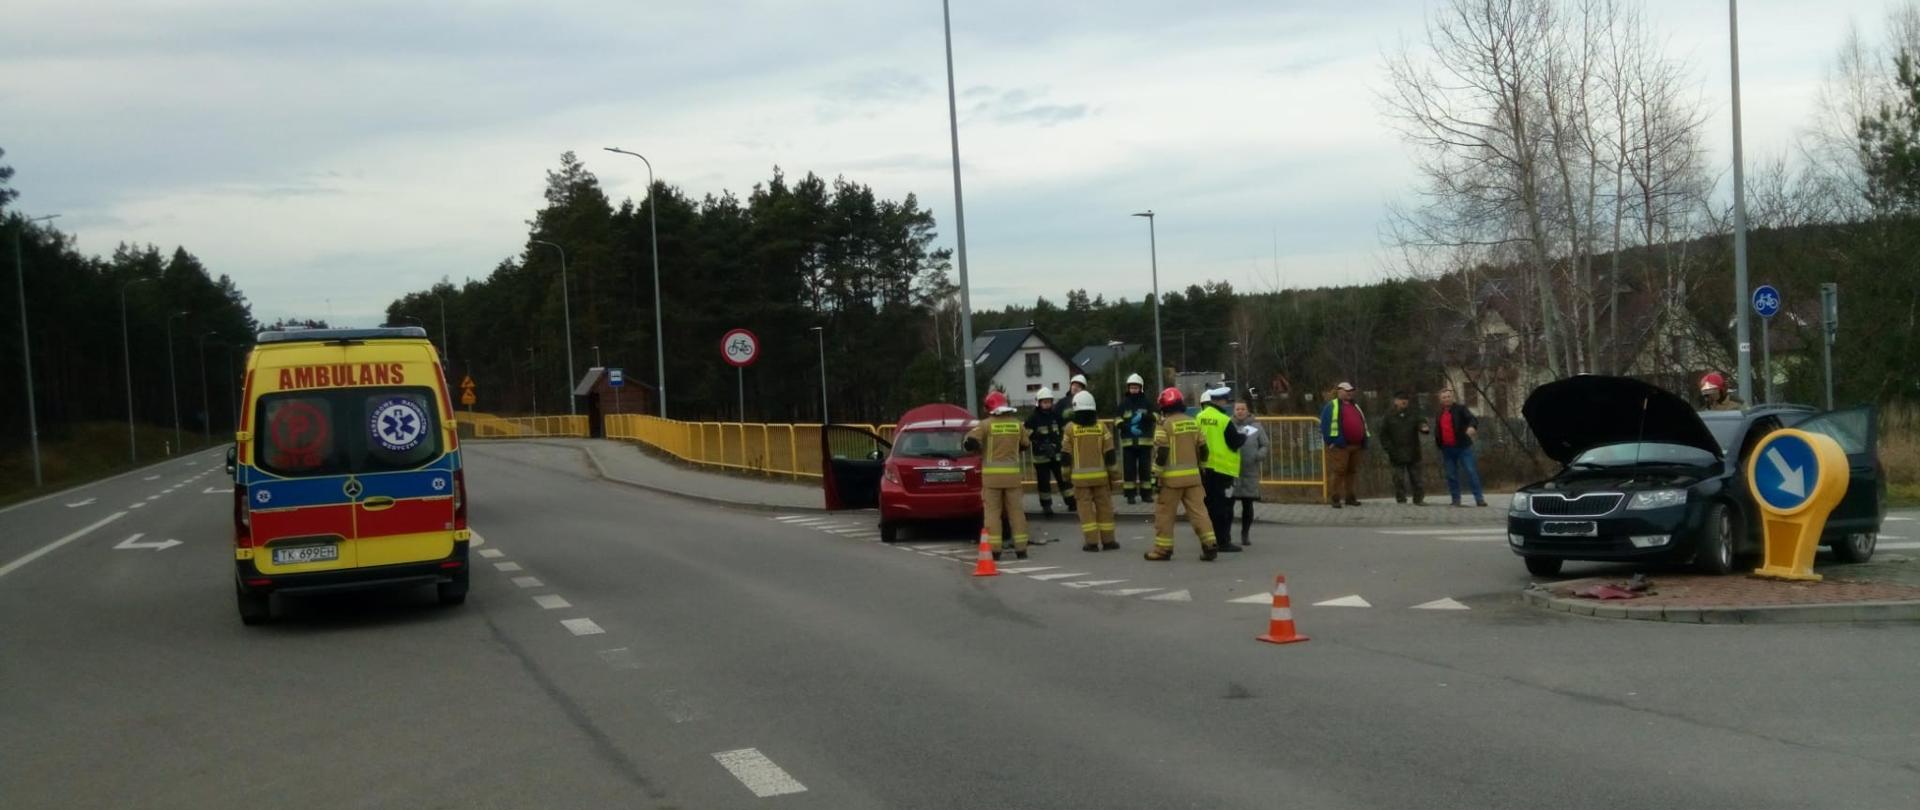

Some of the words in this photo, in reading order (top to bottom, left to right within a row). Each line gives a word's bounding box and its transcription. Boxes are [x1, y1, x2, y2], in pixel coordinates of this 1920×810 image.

[279, 363, 405, 390] AMBULANS
[288, 415, 309, 445] P
[281, 550, 294, 560] TK
[300, 546, 334, 559] 699EH
